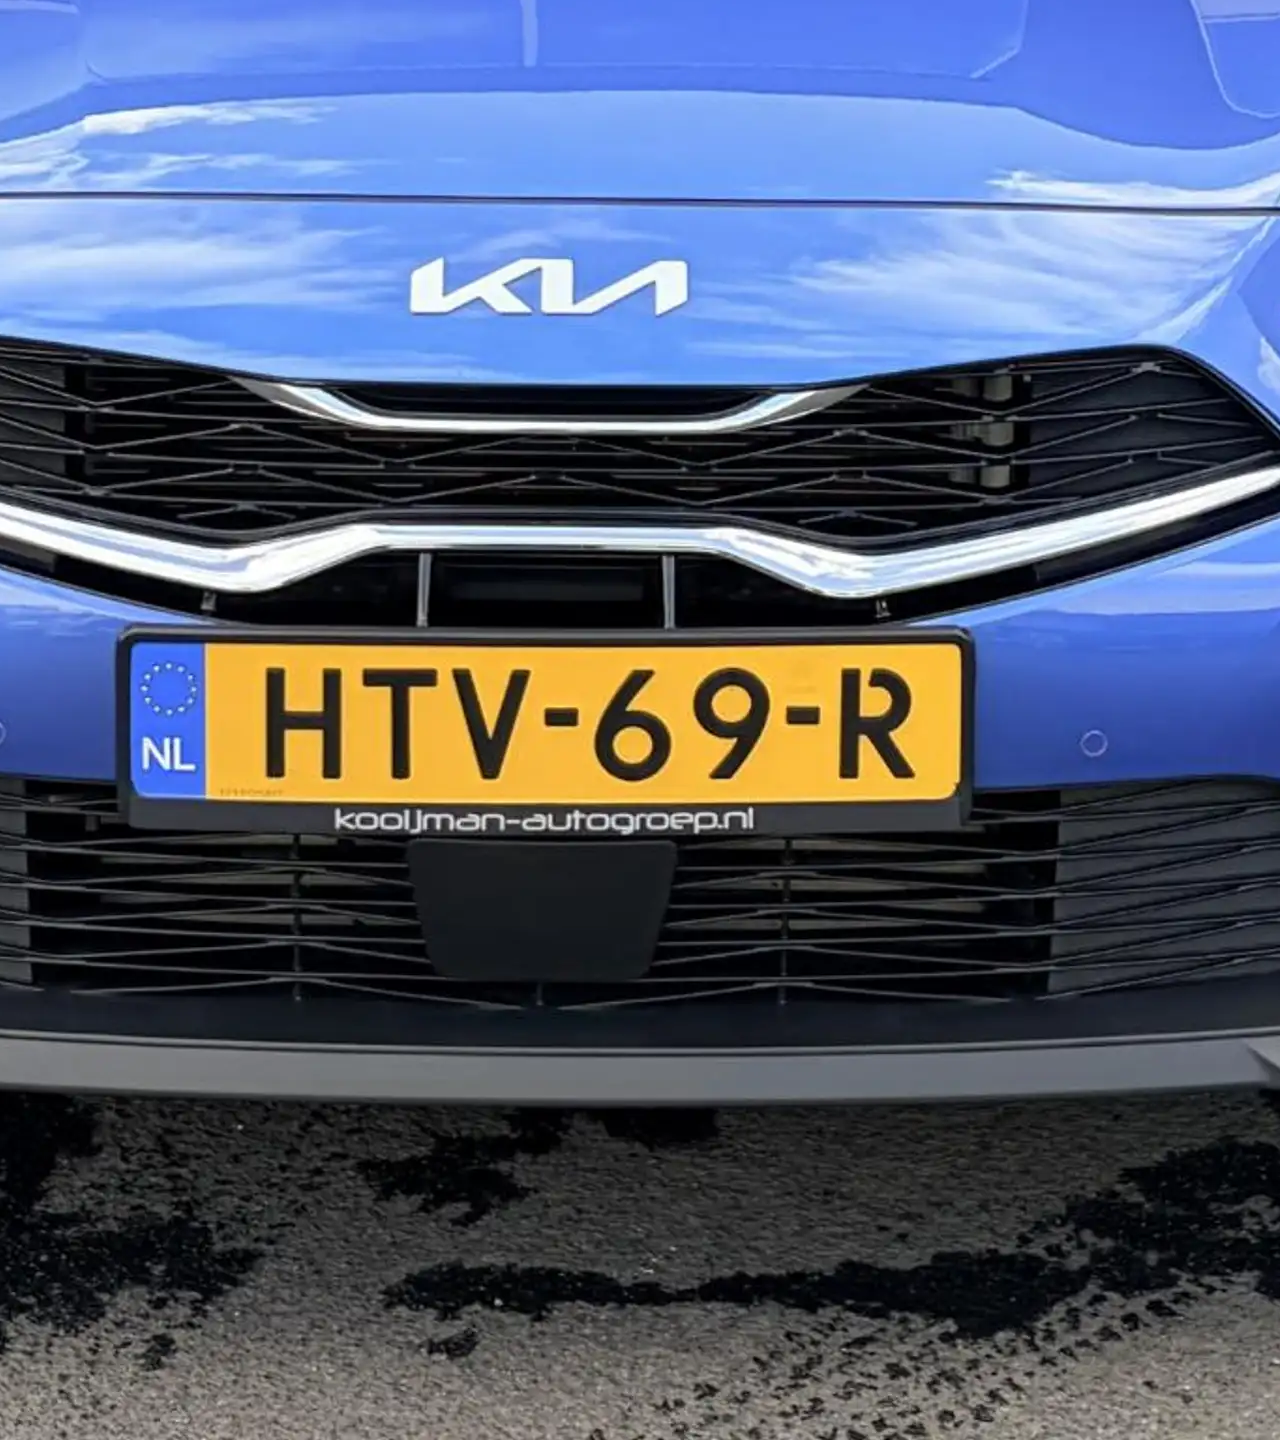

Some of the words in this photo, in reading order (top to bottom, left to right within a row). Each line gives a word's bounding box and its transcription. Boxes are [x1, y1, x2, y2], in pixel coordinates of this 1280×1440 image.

[410, 257, 688, 316] KIA
[265, 667, 915, 781] HTV-69-R
[141, 737, 195, 771] NL
